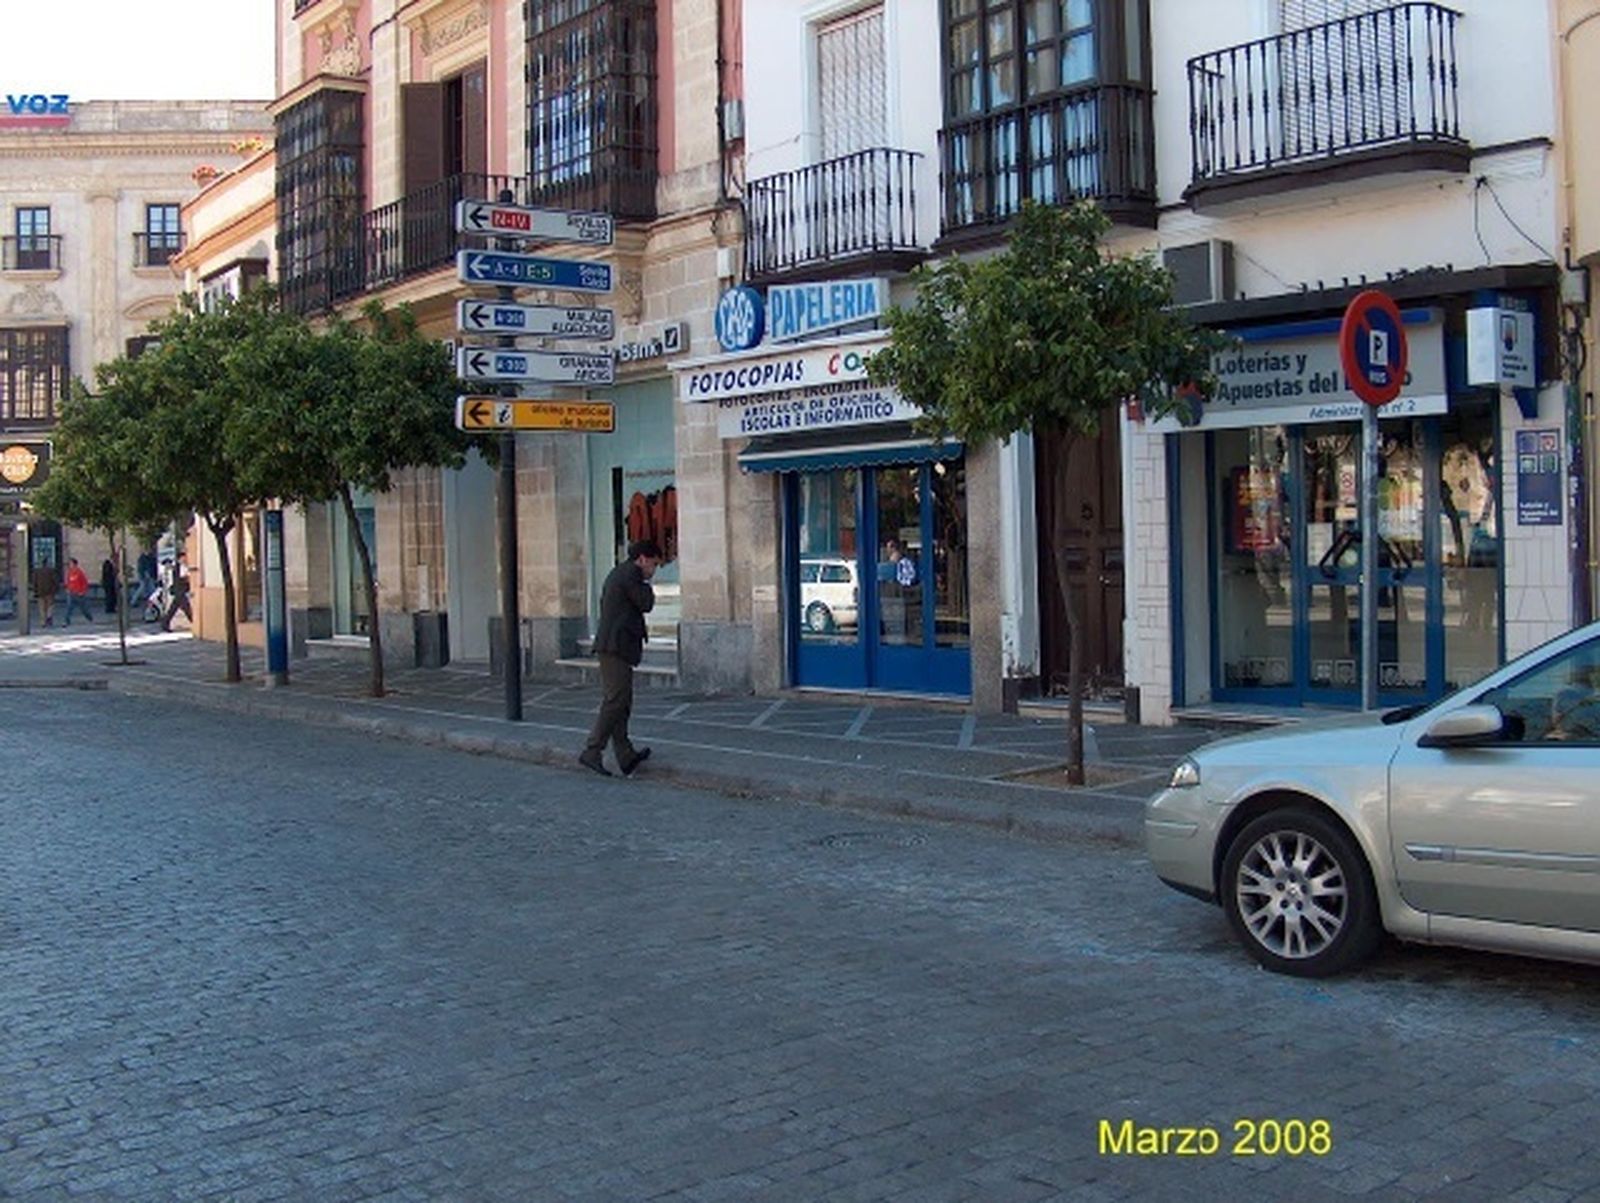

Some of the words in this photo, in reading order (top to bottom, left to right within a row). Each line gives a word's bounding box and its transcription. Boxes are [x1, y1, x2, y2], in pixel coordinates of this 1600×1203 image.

[6, 94, 69, 115] VOZ
[494, 212, 528, 229] N-IV
[772, 283, 876, 338] PAPELERIA
[1215, 351, 1291, 375] Loterías
[1297, 353, 1308, 373] y
[689, 359, 804, 396] FOTOCOPIAS
[1217, 378, 1304, 405] Apuestas
[1309, 372, 1338, 395] del
[741, 414, 791, 432] ESCOLAR
